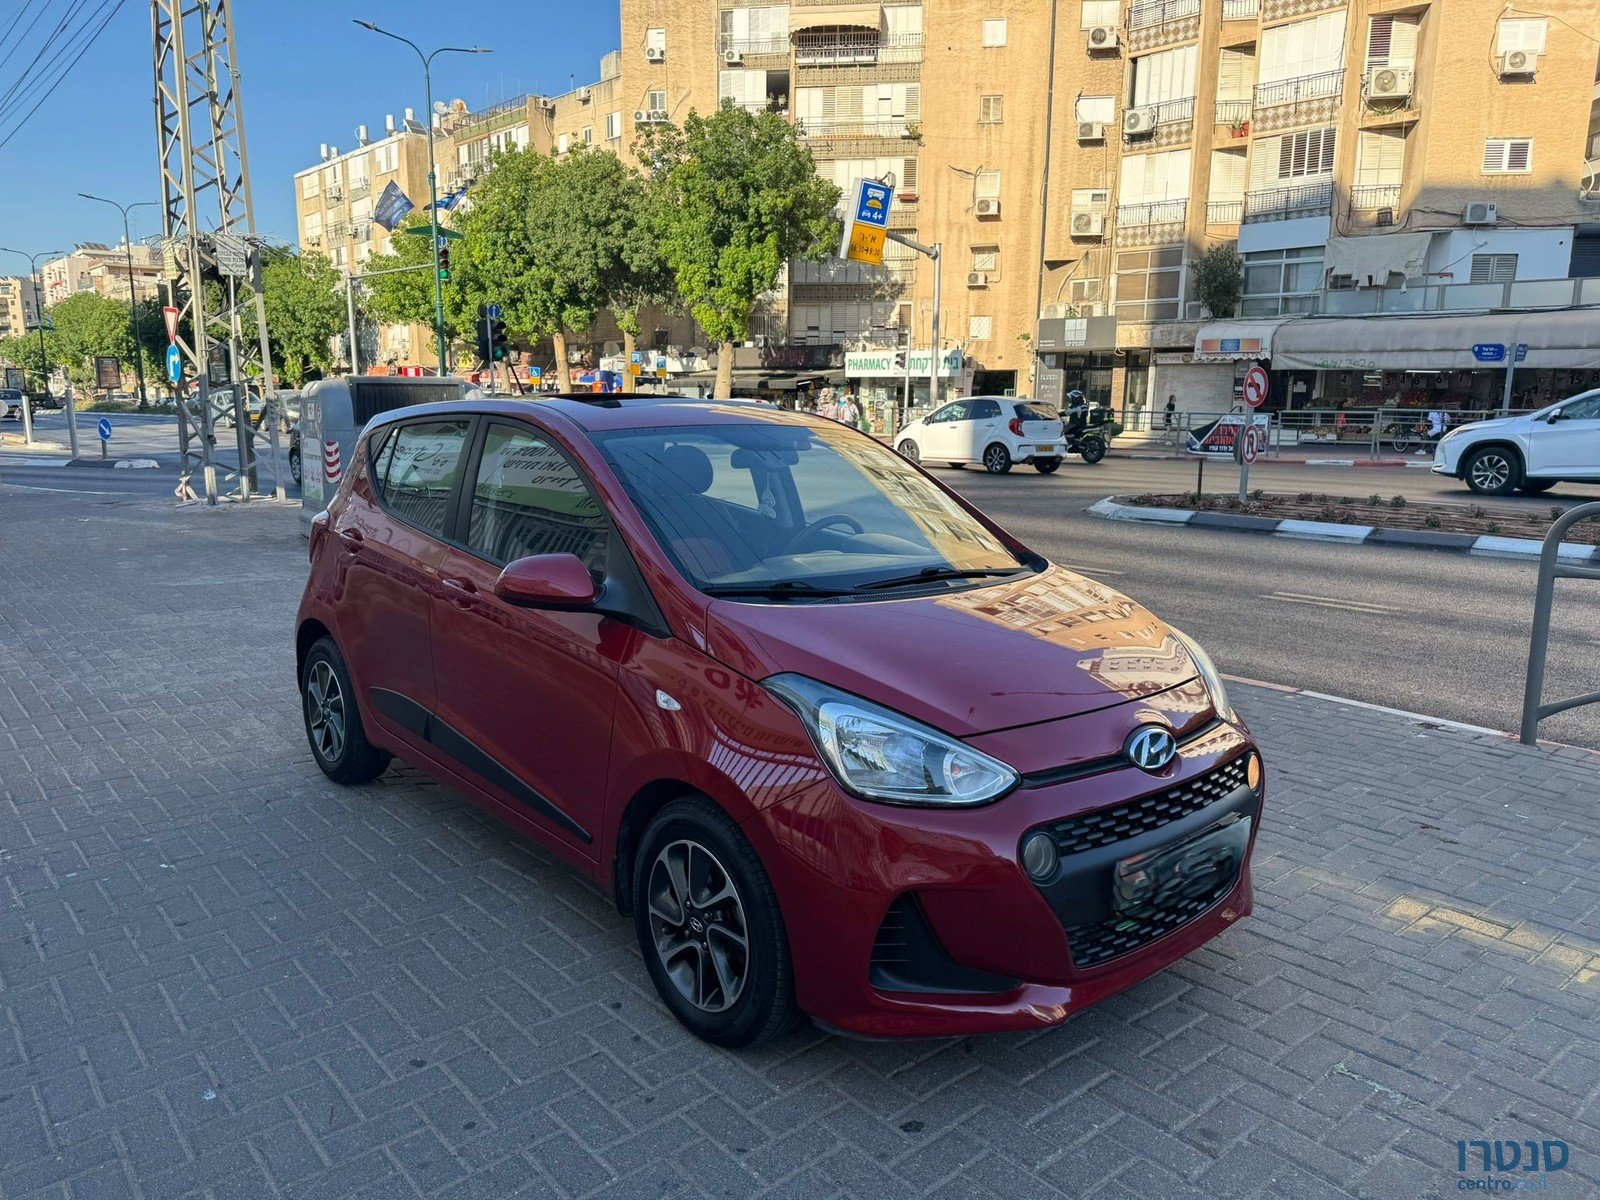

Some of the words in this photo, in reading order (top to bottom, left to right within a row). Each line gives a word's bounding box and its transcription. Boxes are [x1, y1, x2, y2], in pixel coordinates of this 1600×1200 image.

[872, 211, 883, 220] 4+
[847, 358, 892, 371] PHARMACY
[942, 356, 960, 370] בית
